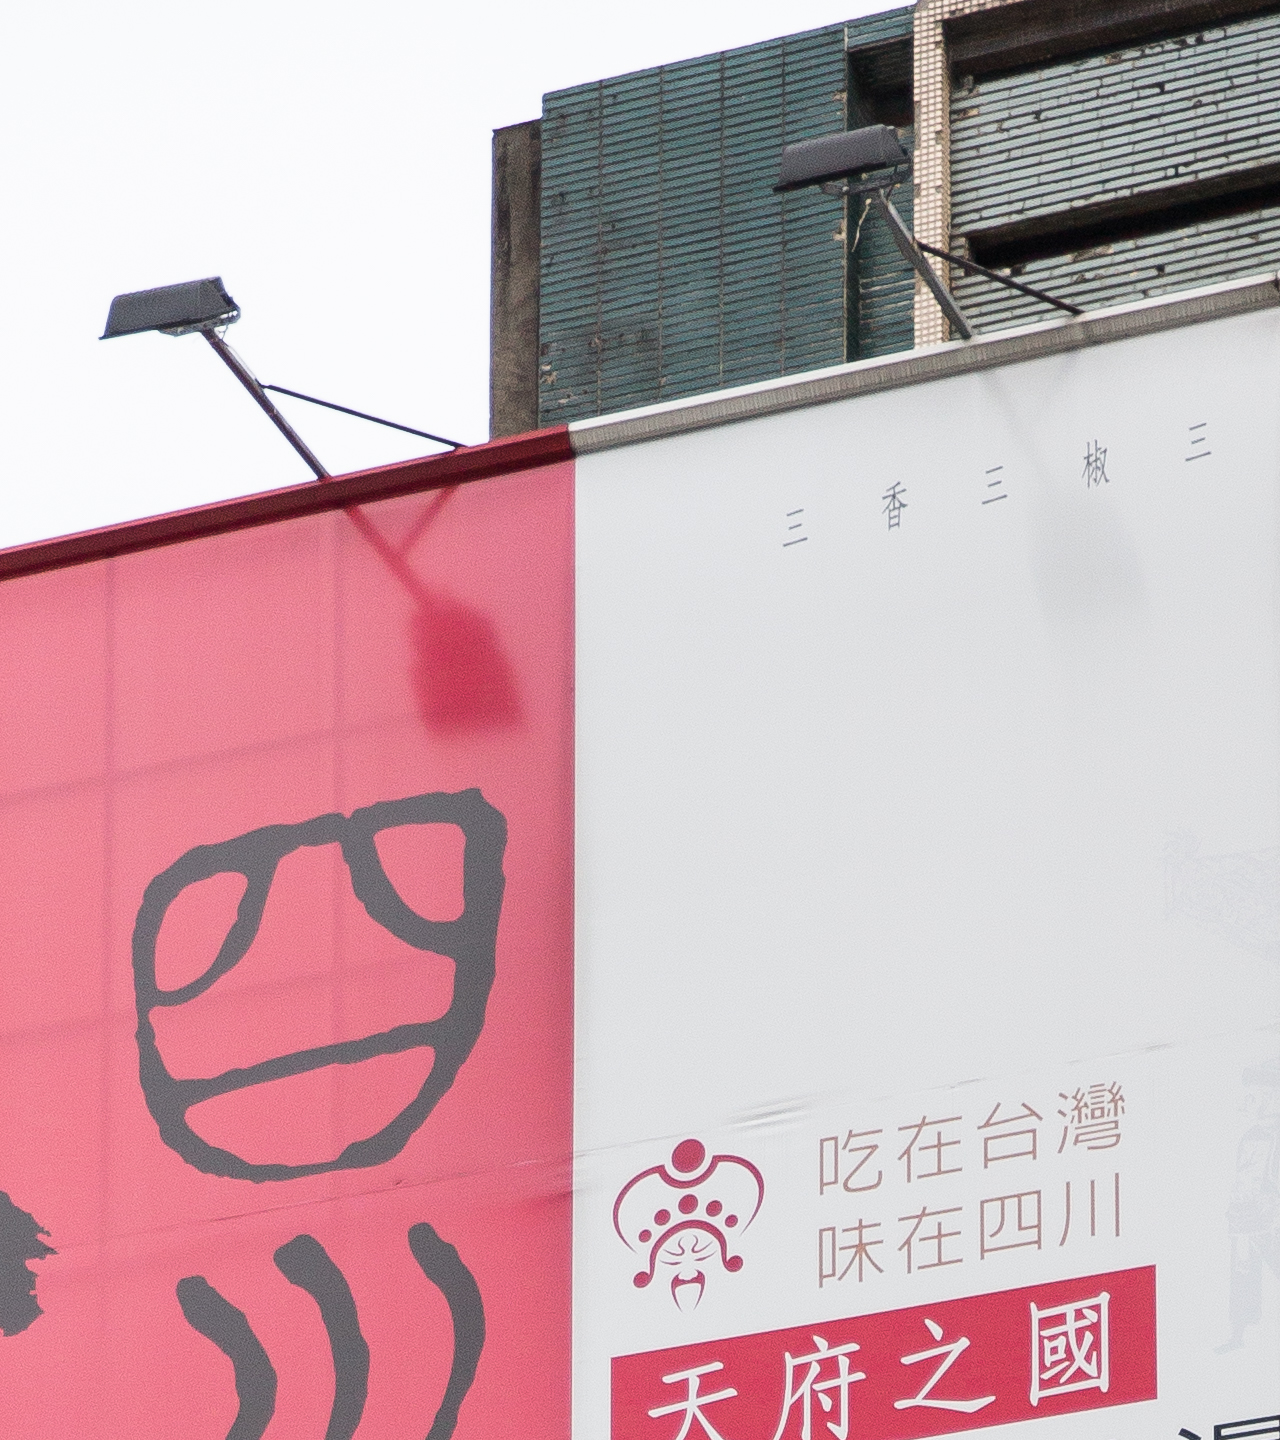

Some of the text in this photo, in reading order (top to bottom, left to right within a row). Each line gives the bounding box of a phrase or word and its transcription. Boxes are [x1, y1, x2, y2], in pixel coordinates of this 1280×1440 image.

[819, 1080, 1127, 1196] 吃在台灣
[818, 1172, 1122, 1289] 味在四川
